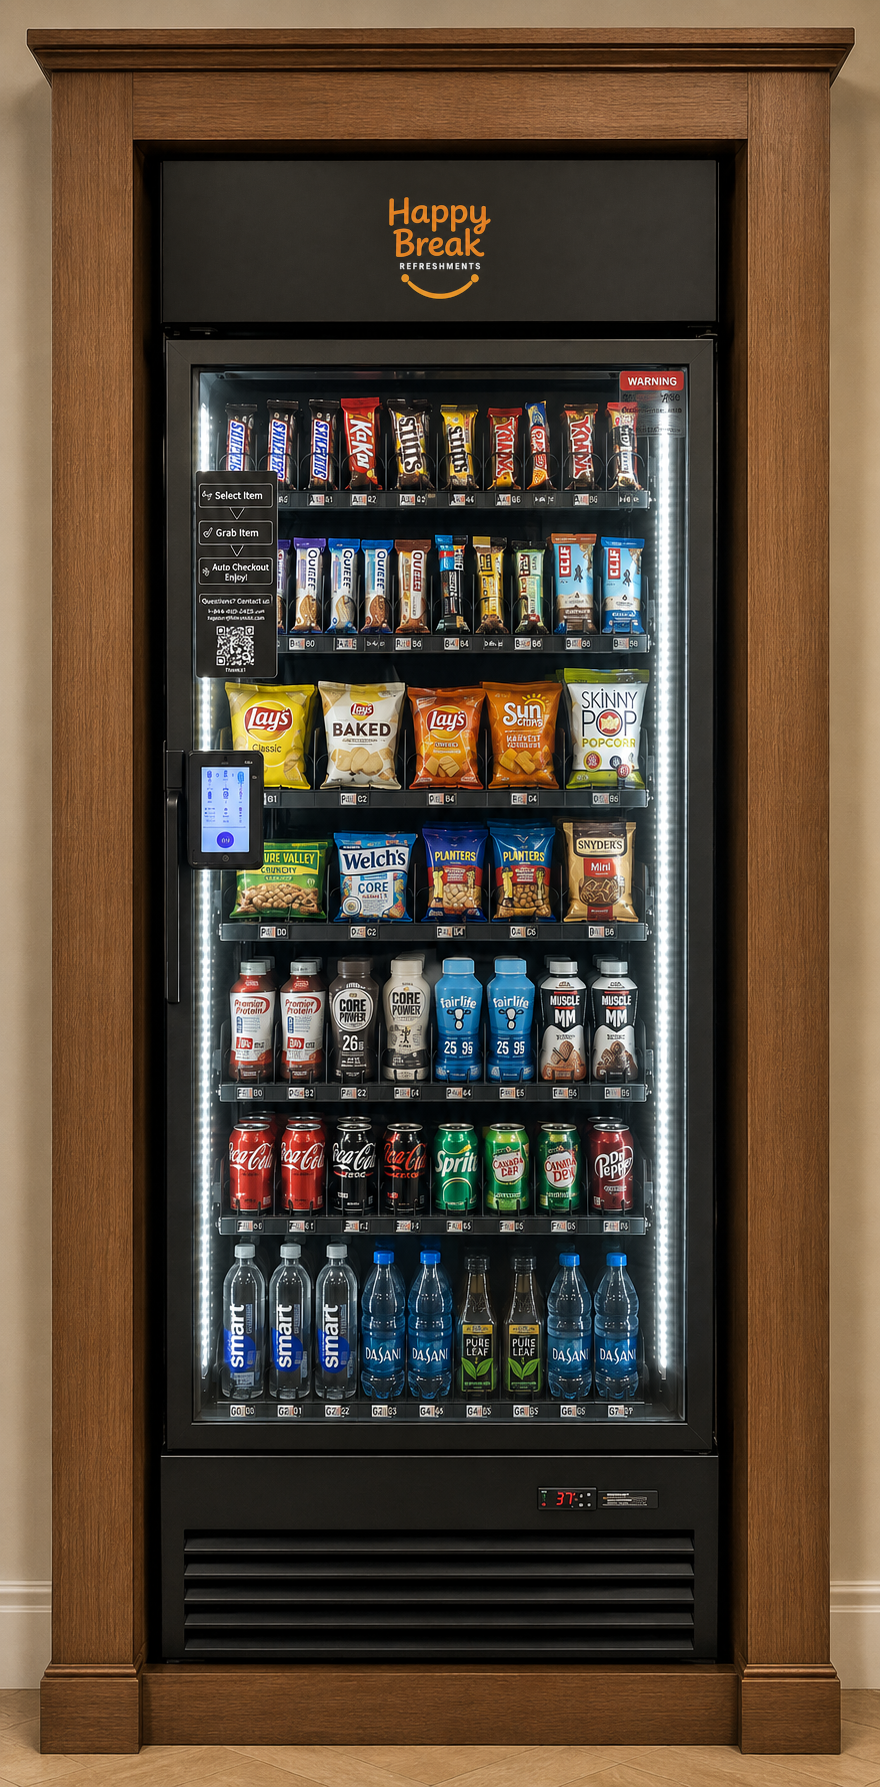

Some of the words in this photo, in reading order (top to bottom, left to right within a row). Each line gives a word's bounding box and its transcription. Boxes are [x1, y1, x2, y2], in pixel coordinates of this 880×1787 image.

[389, 197, 491, 234] Happy
[393, 228, 485, 257] Break
[399, 262, 482, 270] REFRESHMENTS
[627, 376, 678, 387] WARNING
[215, 491, 241, 500] Select
[243, 491, 263, 500] Item
[215, 528, 237, 537] Grab
[239, 528, 259, 537] Item
[212, 563, 231, 571] Auto
[232, 563, 270, 571] Checkout
[582, 688, 638, 709] SKINNY
[247, 706, 291, 731] Lay's
[430, 710, 465, 731] Lay's
[502, 702, 542, 726] Sun
[332, 722, 392, 737] BAKED
[582, 709, 637, 737] POP
[252, 743, 282, 753] Classic
[578, 840, 623, 850] SNYDER'S
[283, 853, 315, 865] VALLEY
[342, 849, 406, 870] Welch's
[435, 850, 477, 862] PLANTERS
[503, 850, 545, 862] PLANTERS
[358, 881, 389, 893] CORE
[339, 999, 366, 1012] CORE
[392, 992, 421, 1005] CORE
[550, 995, 580, 1006] MUSCLE
[601, 995, 632, 1006] MUSCLE
[392, 1005, 421, 1016] POWER
[342, 1035, 358, 1051] 26
[230, 1303, 245, 1368] smart
[278, 1303, 293, 1368] smart
[325, 1303, 339, 1368] smart
[365, 1347, 401, 1363] DASANI
[412, 1347, 448, 1363] DASANI
[552, 1347, 589, 1365] DASANI
[599, 1347, 636, 1365] DASANI
